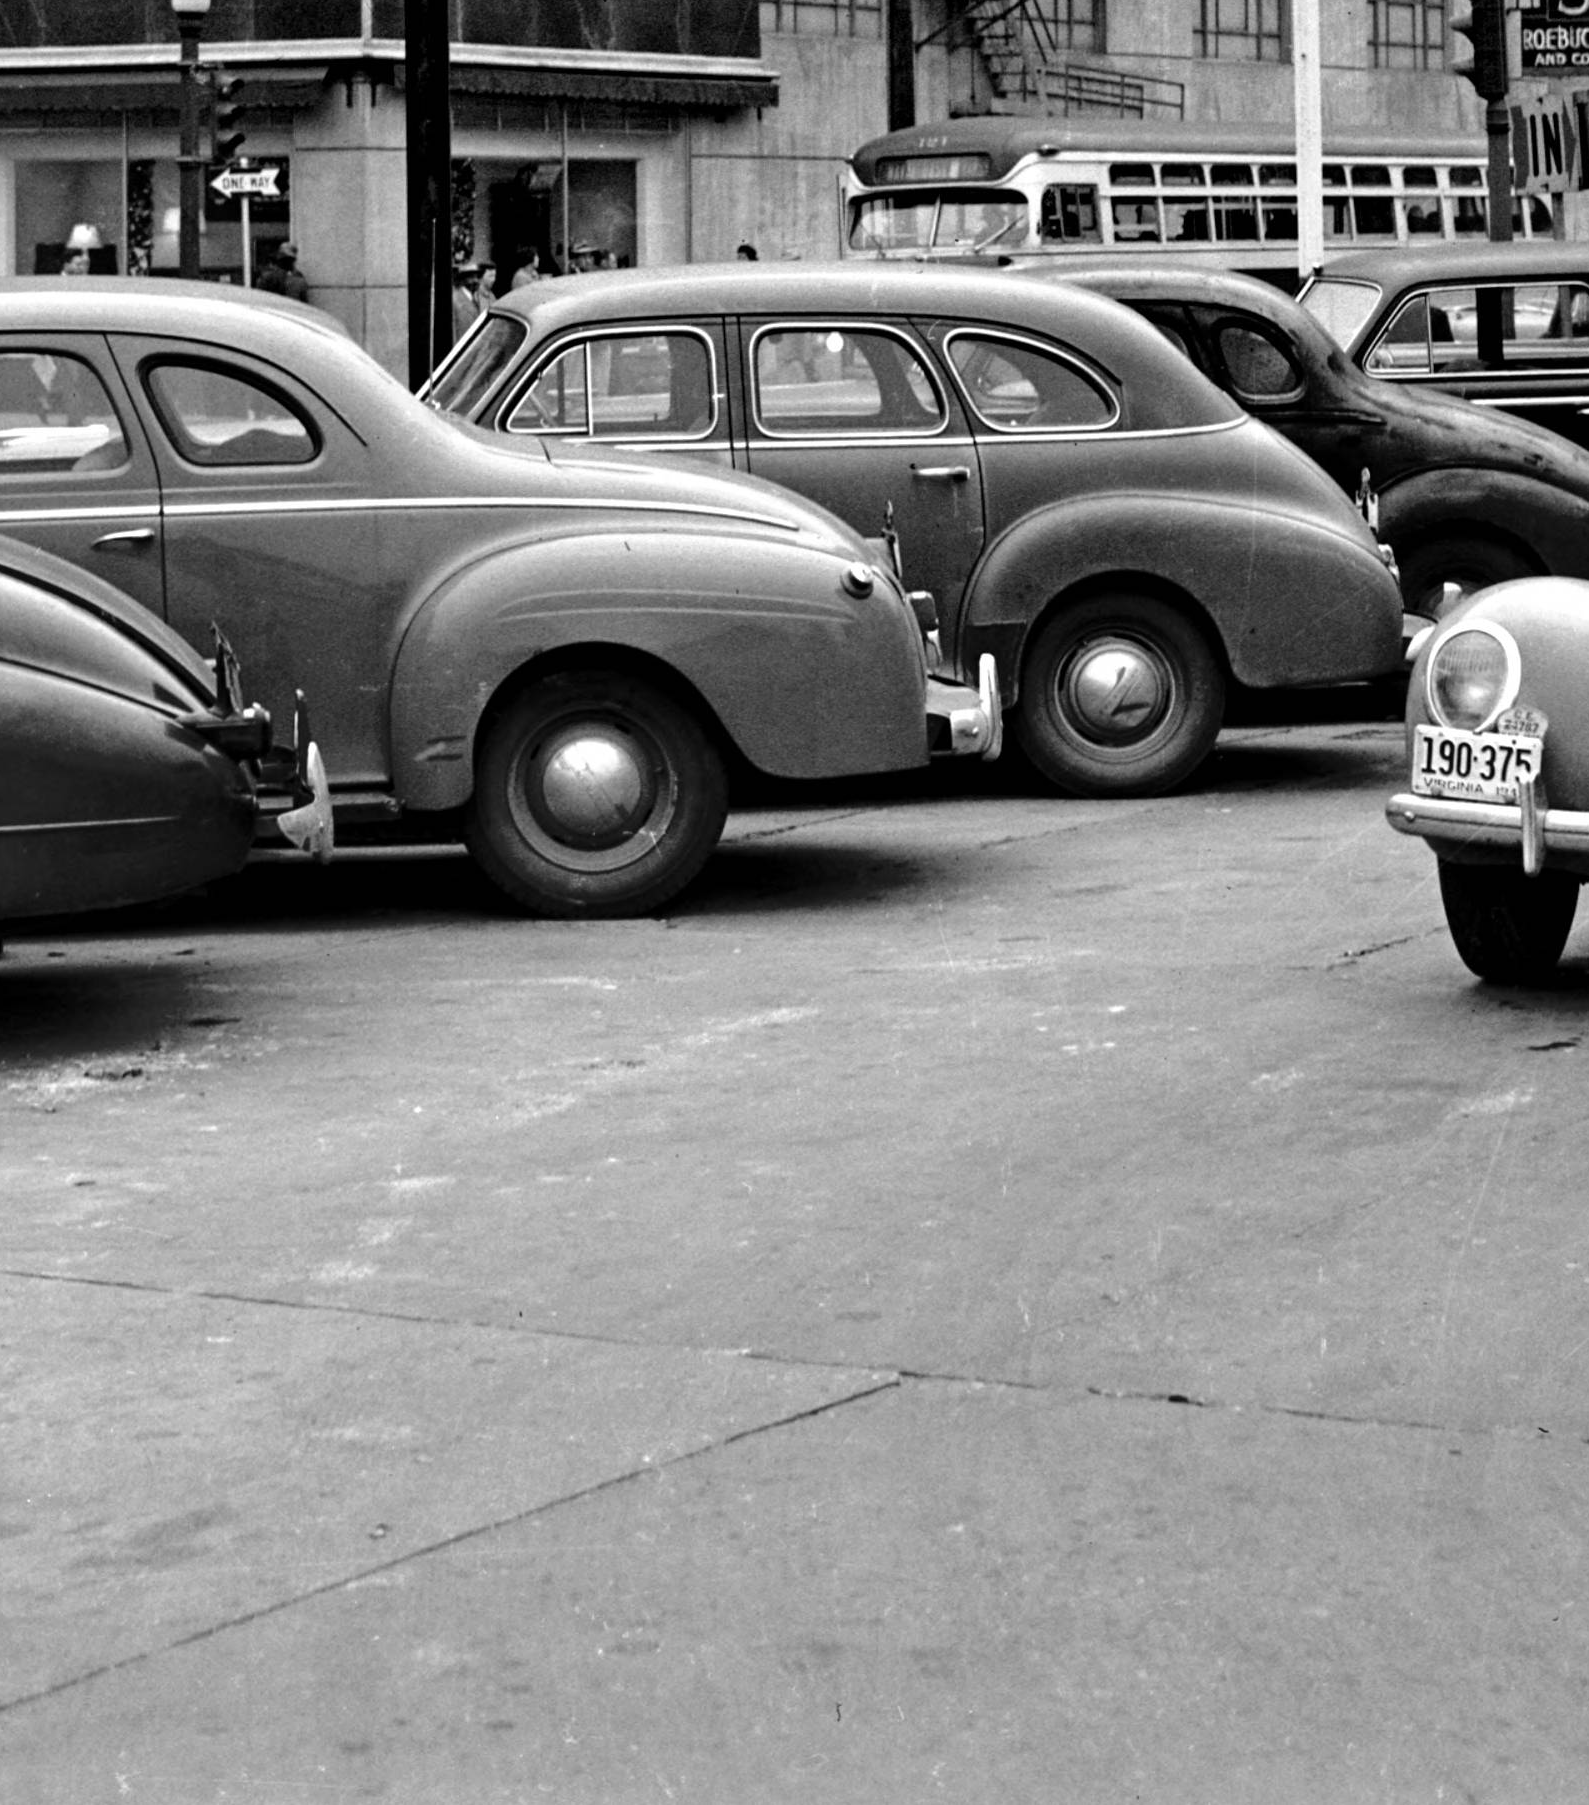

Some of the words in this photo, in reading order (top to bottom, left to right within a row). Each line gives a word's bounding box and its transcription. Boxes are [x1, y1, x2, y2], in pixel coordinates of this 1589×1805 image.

[1535, 53, 1566, 67] AND
[1529, 112, 1564, 178] IN
[221, 177, 245, 191] ONE
[250, 176, 271, 189] WAY
[1424, 777, 1485, 794] VIRGINIA
